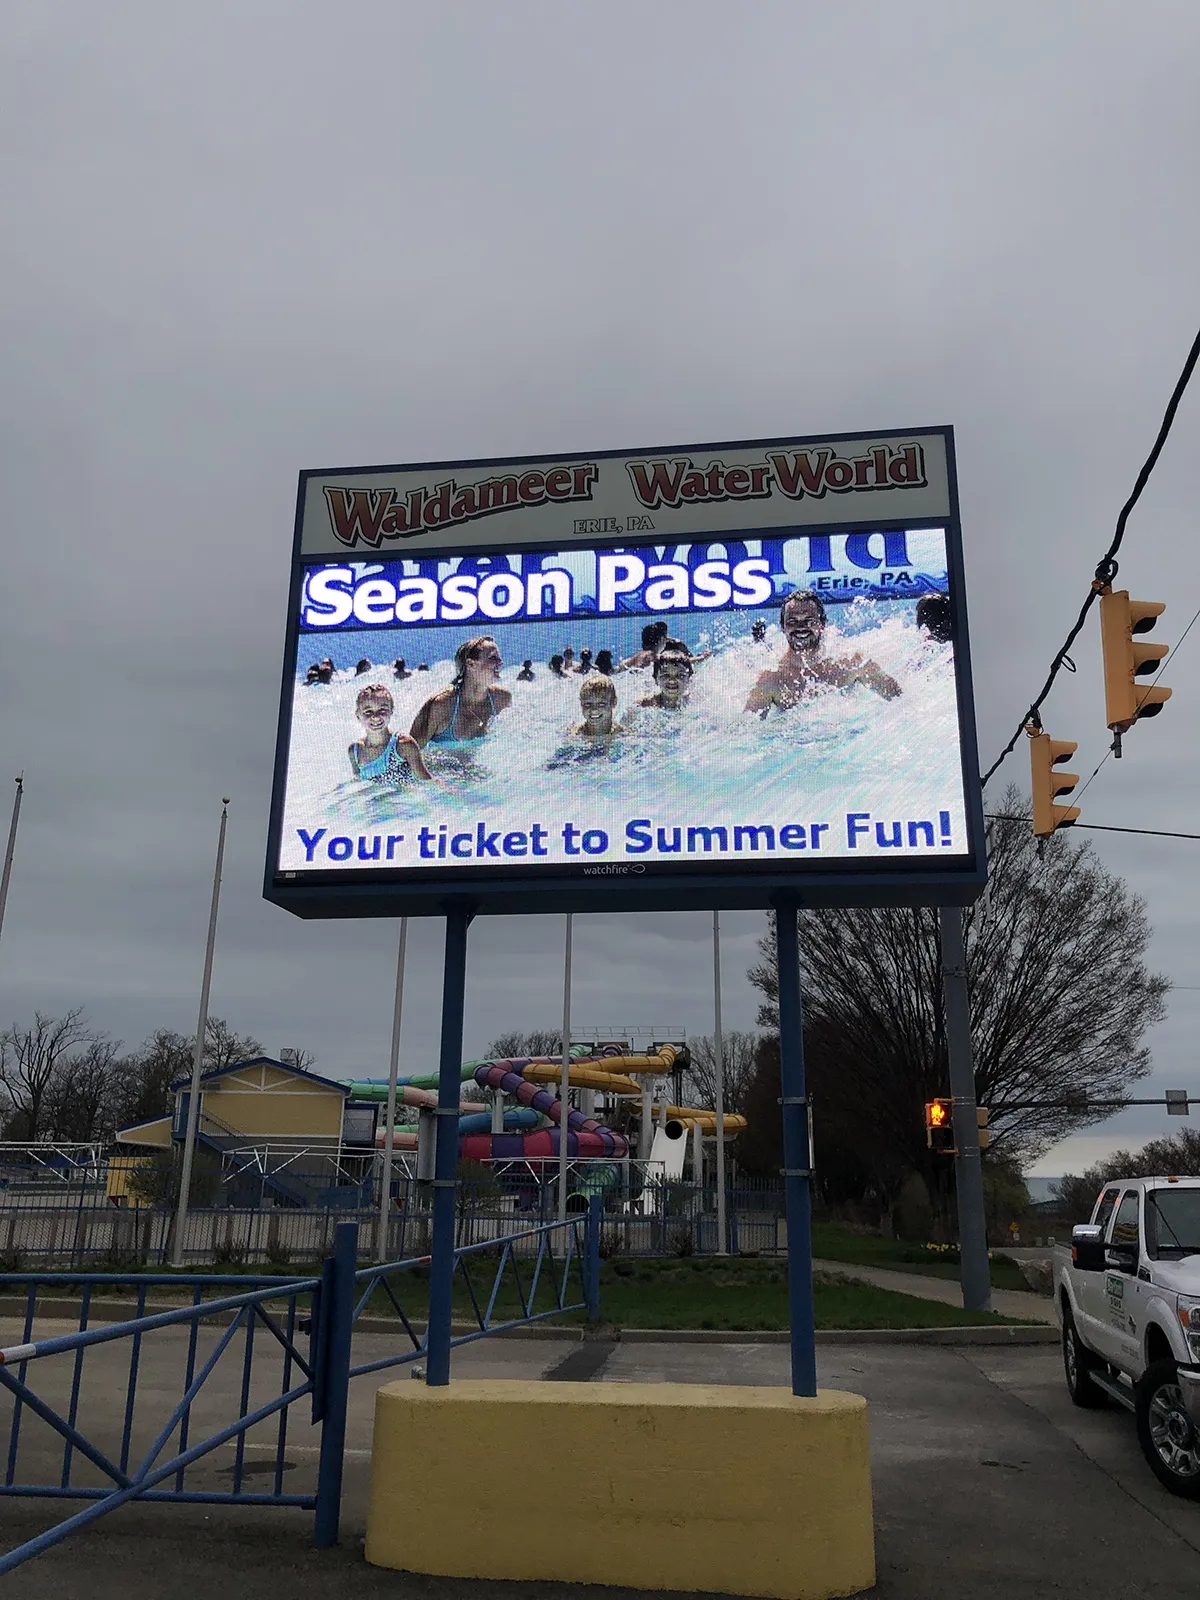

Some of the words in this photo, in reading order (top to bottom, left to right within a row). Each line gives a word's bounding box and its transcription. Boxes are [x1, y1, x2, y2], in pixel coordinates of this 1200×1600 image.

[323, 463, 598, 548] Waldameer
[573, 515, 623, 535] ERIE,
[627, 515, 655, 531] PA
[306, 567, 571, 626] Season
[598, 553, 773, 612] Pass
[879, 569, 911, 585] PA
[297, 826, 404, 862] Your
[418, 822, 548, 859] ticket
[562, 822, 609, 855] to
[625, 819, 829, 853] Summer
[846, 811, 952, 849] Fun!
[584, 864, 629, 875] watchfire
